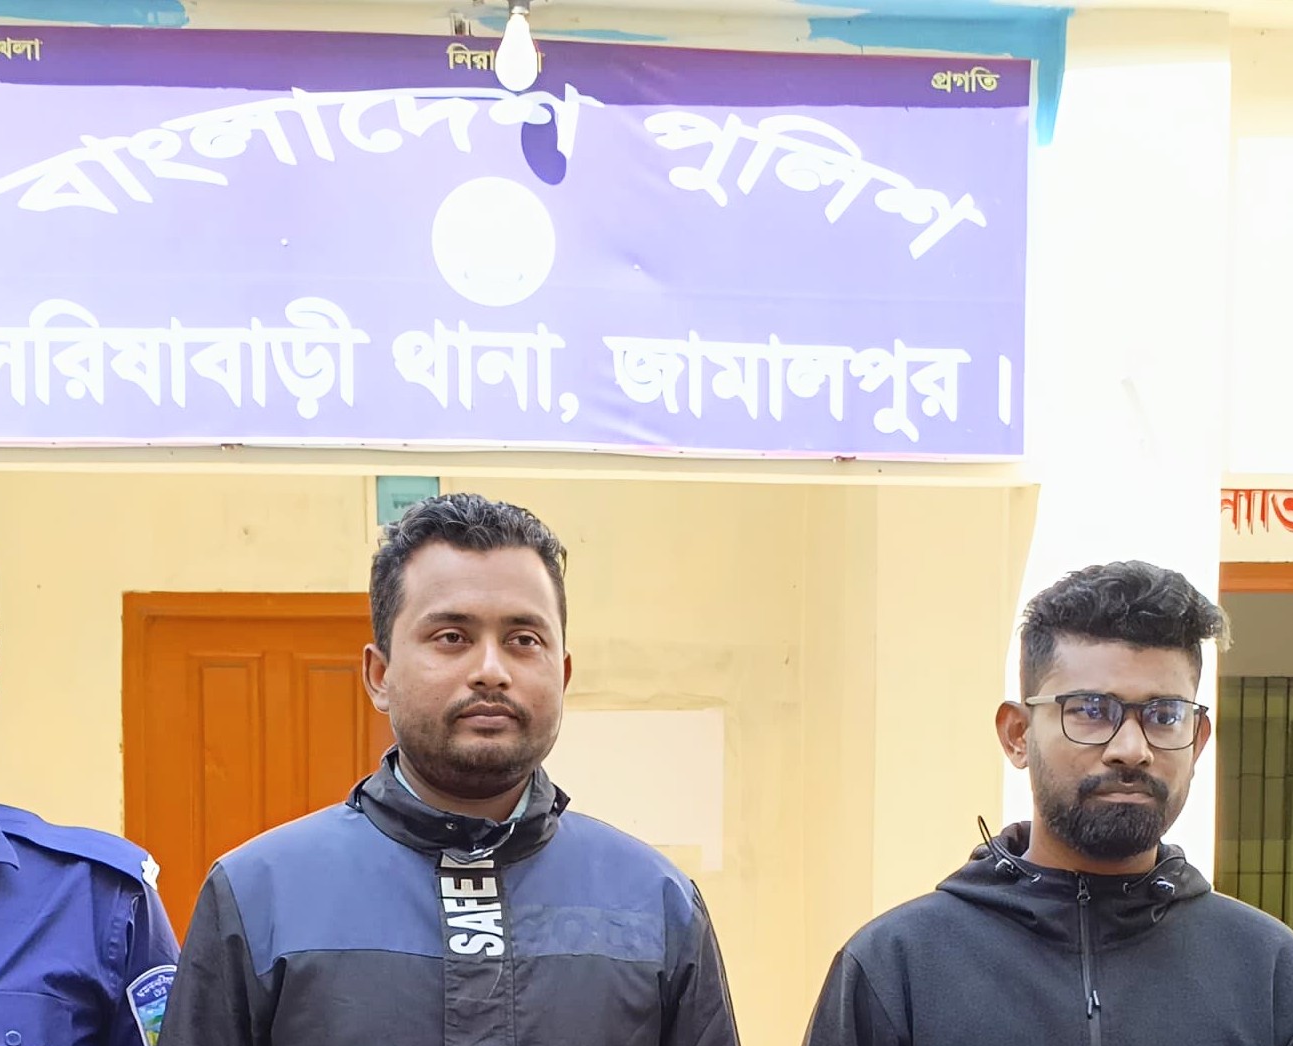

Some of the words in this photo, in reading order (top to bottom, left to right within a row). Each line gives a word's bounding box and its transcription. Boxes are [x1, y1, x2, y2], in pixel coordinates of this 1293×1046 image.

[930, 66, 1001, 94] প্রগতি
[643, 111, 987, 260] পুলিশ
[392, 319, 580, 423] থানা,
[602, 330, 971, 442] জামালপুর
